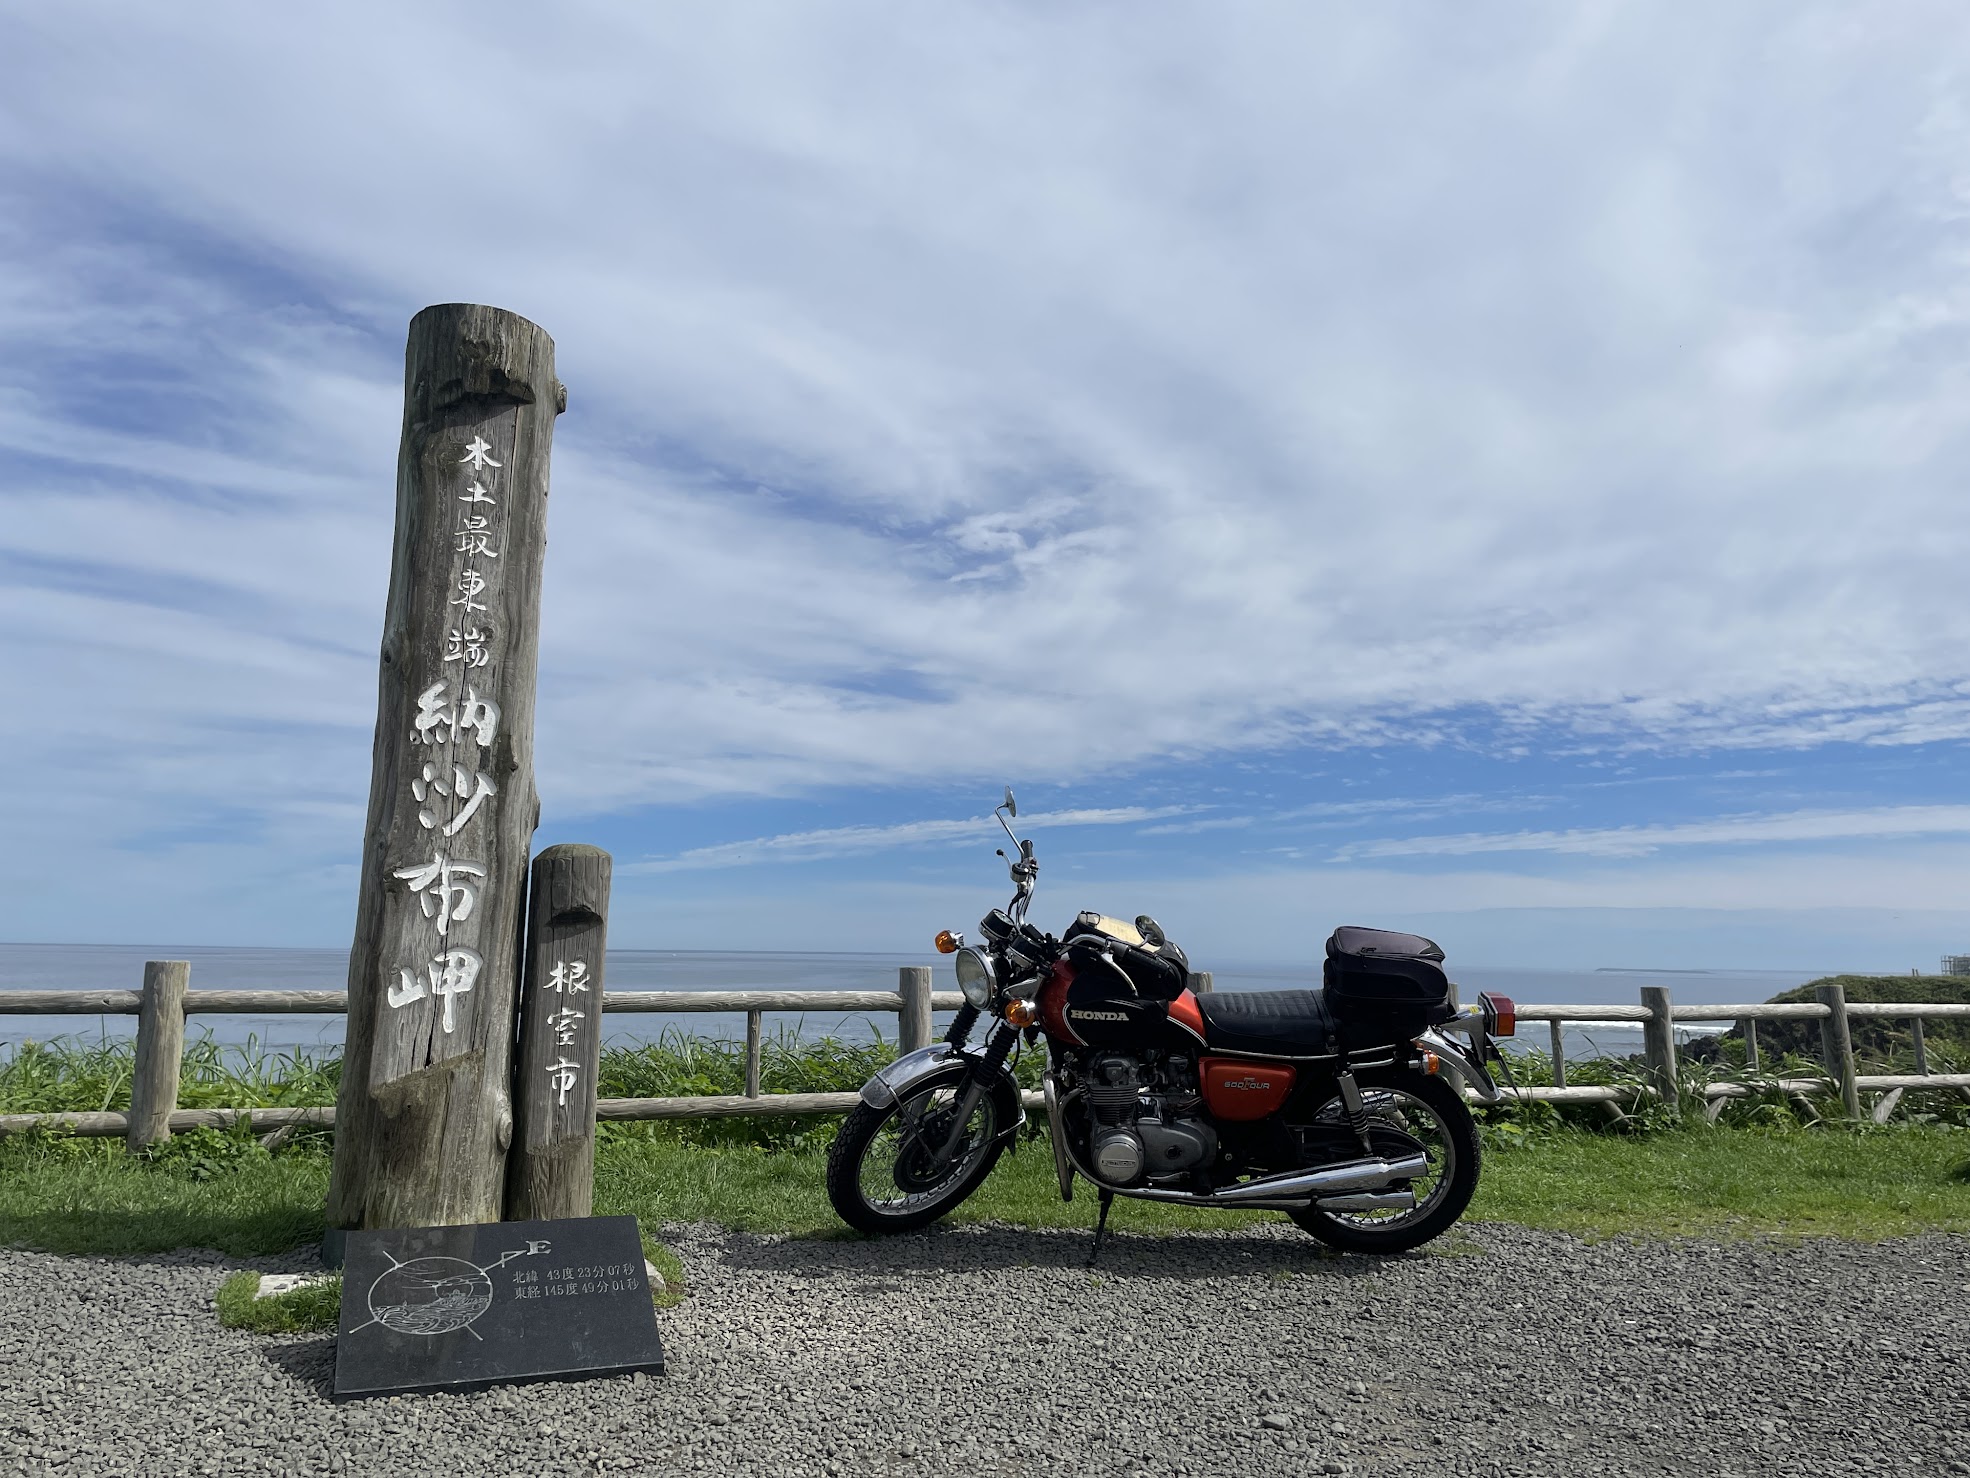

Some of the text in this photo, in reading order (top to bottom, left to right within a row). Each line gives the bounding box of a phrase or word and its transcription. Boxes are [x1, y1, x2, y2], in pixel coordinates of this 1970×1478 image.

[444, 435, 502, 669] 本土最東端
[387, 677, 501, 1034] 納沙布岬
[543, 960, 591, 1107] 根室市
[1070, 1009, 1130, 1021] HONDA
[525, 1240, 552, 1256] E
